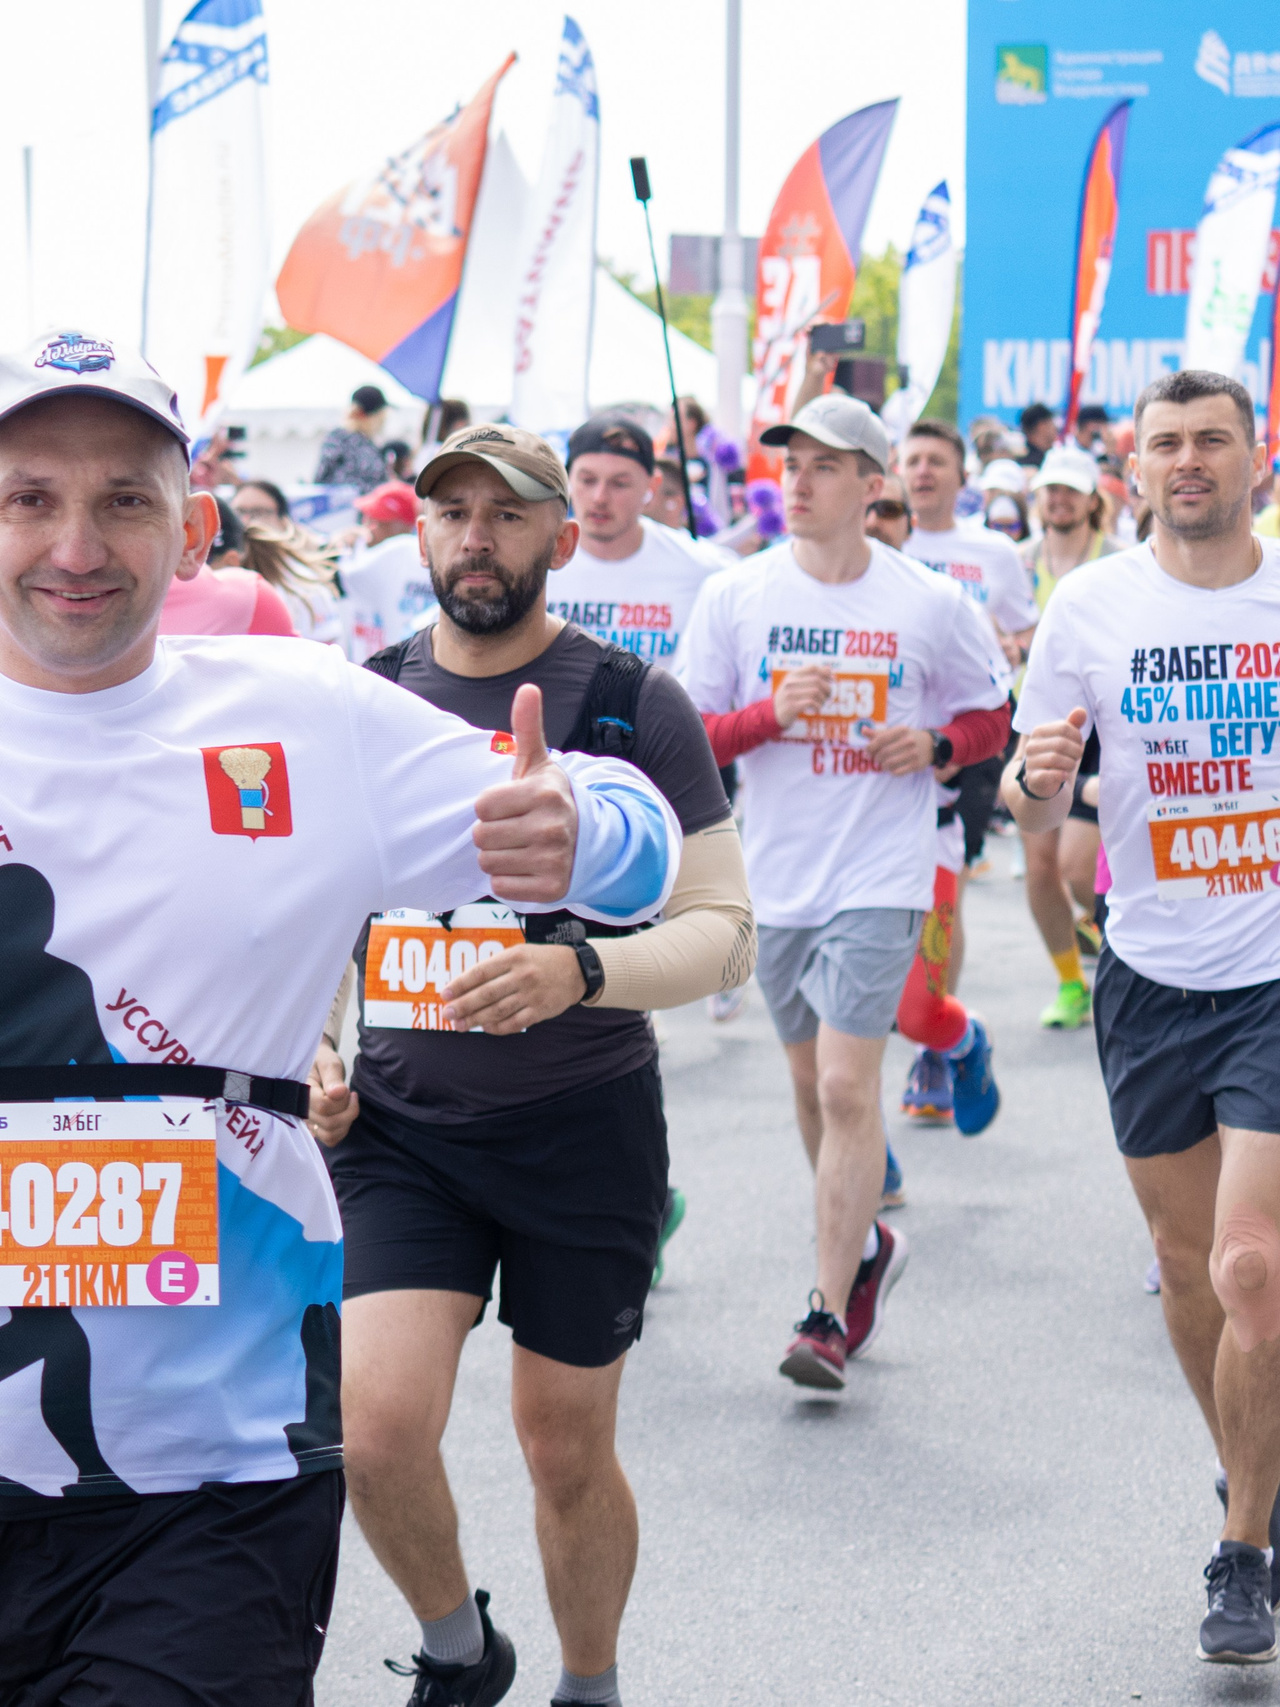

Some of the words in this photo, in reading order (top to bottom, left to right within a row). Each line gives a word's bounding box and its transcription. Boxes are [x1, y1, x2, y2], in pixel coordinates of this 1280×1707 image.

[984, 338, 1272, 407] КИЛОМЕЫ
[768, 626, 898, 660] #ЗАБЕГ2025
[1120, 686, 1179, 724] 45%
[1185, 681, 1280, 721] ПЛАНЕ
[1209, 721, 1280, 758] БЕГУ
[811, 744, 825, 775] С
[1146, 759, 1254, 797] ВМЕСТЕ
[1169, 806, 1189, 815] ПСБ
[1170, 818, 1280, 872] 40446
[389, 910, 406, 919] ПСБ
[105, 987, 196, 1066] УССУР
[160, 1261, 186, 1293] E
